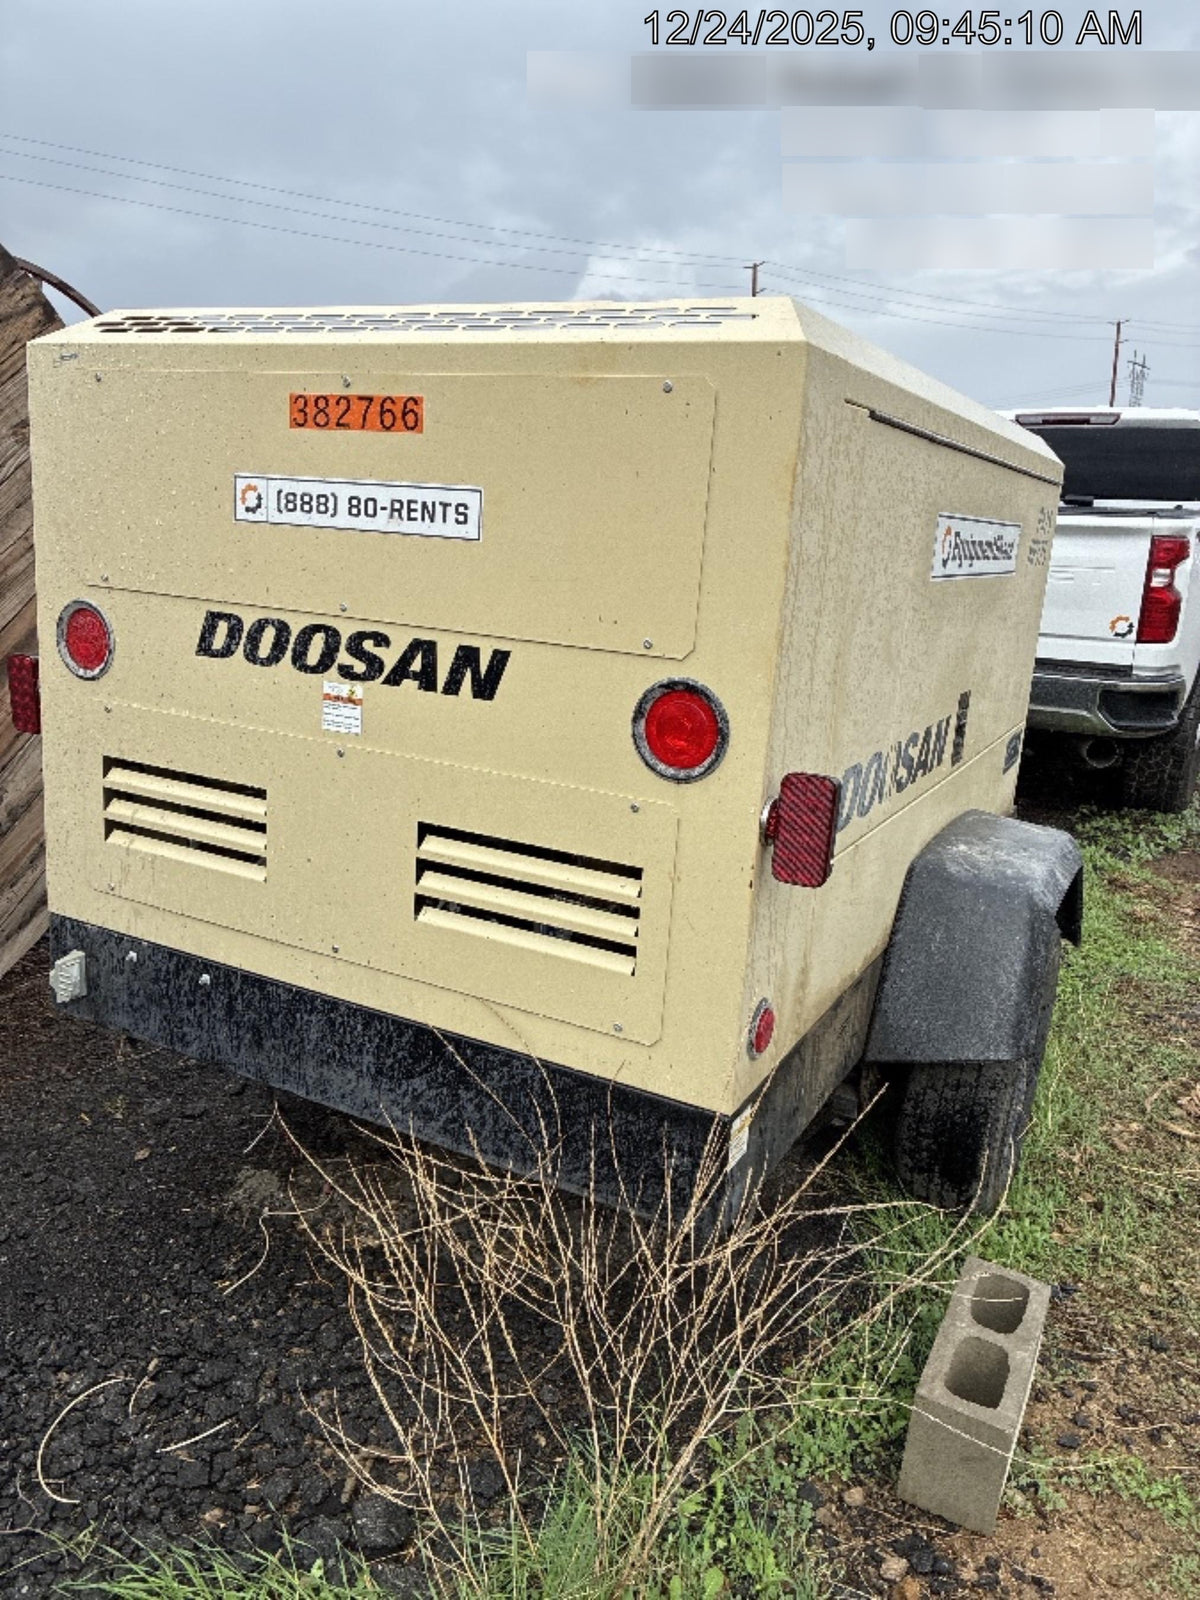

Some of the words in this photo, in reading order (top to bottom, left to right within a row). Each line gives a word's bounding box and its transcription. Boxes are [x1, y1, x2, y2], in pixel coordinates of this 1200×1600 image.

[292, 395, 420, 431] 382766
[276, 488, 338, 516] (888)
[347, 495, 470, 526] 80-RENTS
[195, 609, 512, 701] DOOSAN
